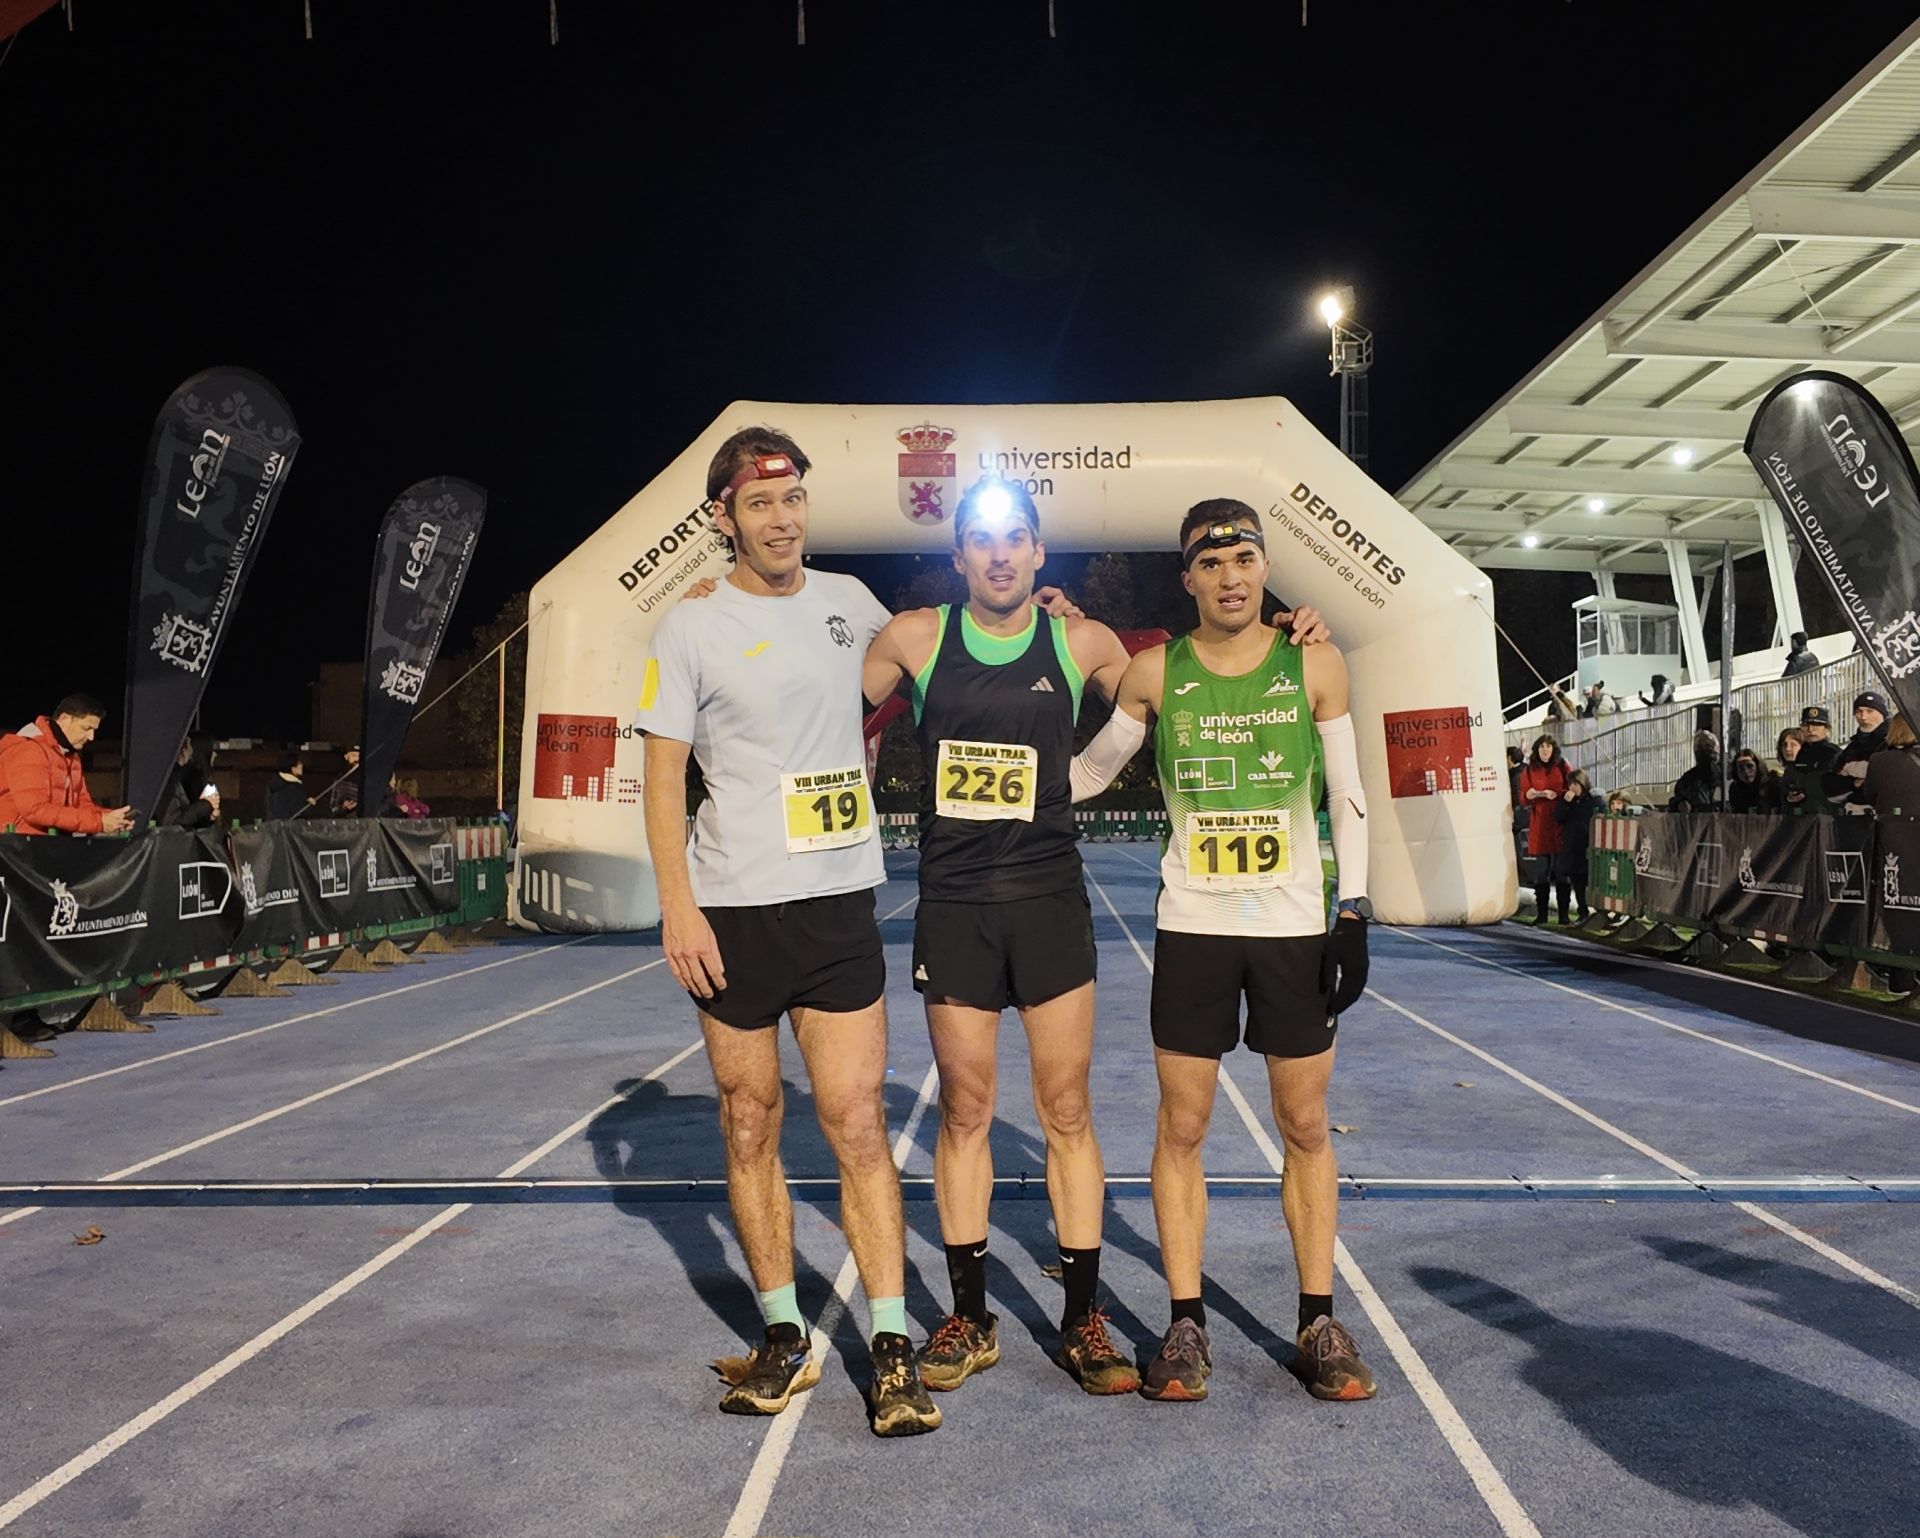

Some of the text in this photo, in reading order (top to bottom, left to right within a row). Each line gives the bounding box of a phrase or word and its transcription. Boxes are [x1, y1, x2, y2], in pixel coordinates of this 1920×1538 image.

[978, 445, 1130, 469] universidad
[210, 451, 281, 627] AYUNTAMIENTO DE LEÓN
[617, 498, 715, 592] DEPORTE
[1290, 482, 1406, 585] DEPORTES
[1269, 503, 1386, 609] Universidad de León
[637, 536, 726, 614] Universidad de
[1199, 706, 1298, 728] universidad
[1385, 711, 1483, 736] universidad
[537, 722, 632, 739] universidad
[1199, 728, 1254, 744] de león
[964, 746, 998, 758] URBAN
[1000, 748, 1028, 760] TRAIL
[794, 777, 812, 788] VIII
[814, 772, 845, 787] URBAN
[946, 764, 1025, 804] 226
[1179, 768, 1202, 780] LEÓN
[811, 791, 858, 832] 19
[1197, 815, 1280, 828] VIII URBAN TRAIL
[1198, 834, 1280, 873] 119
